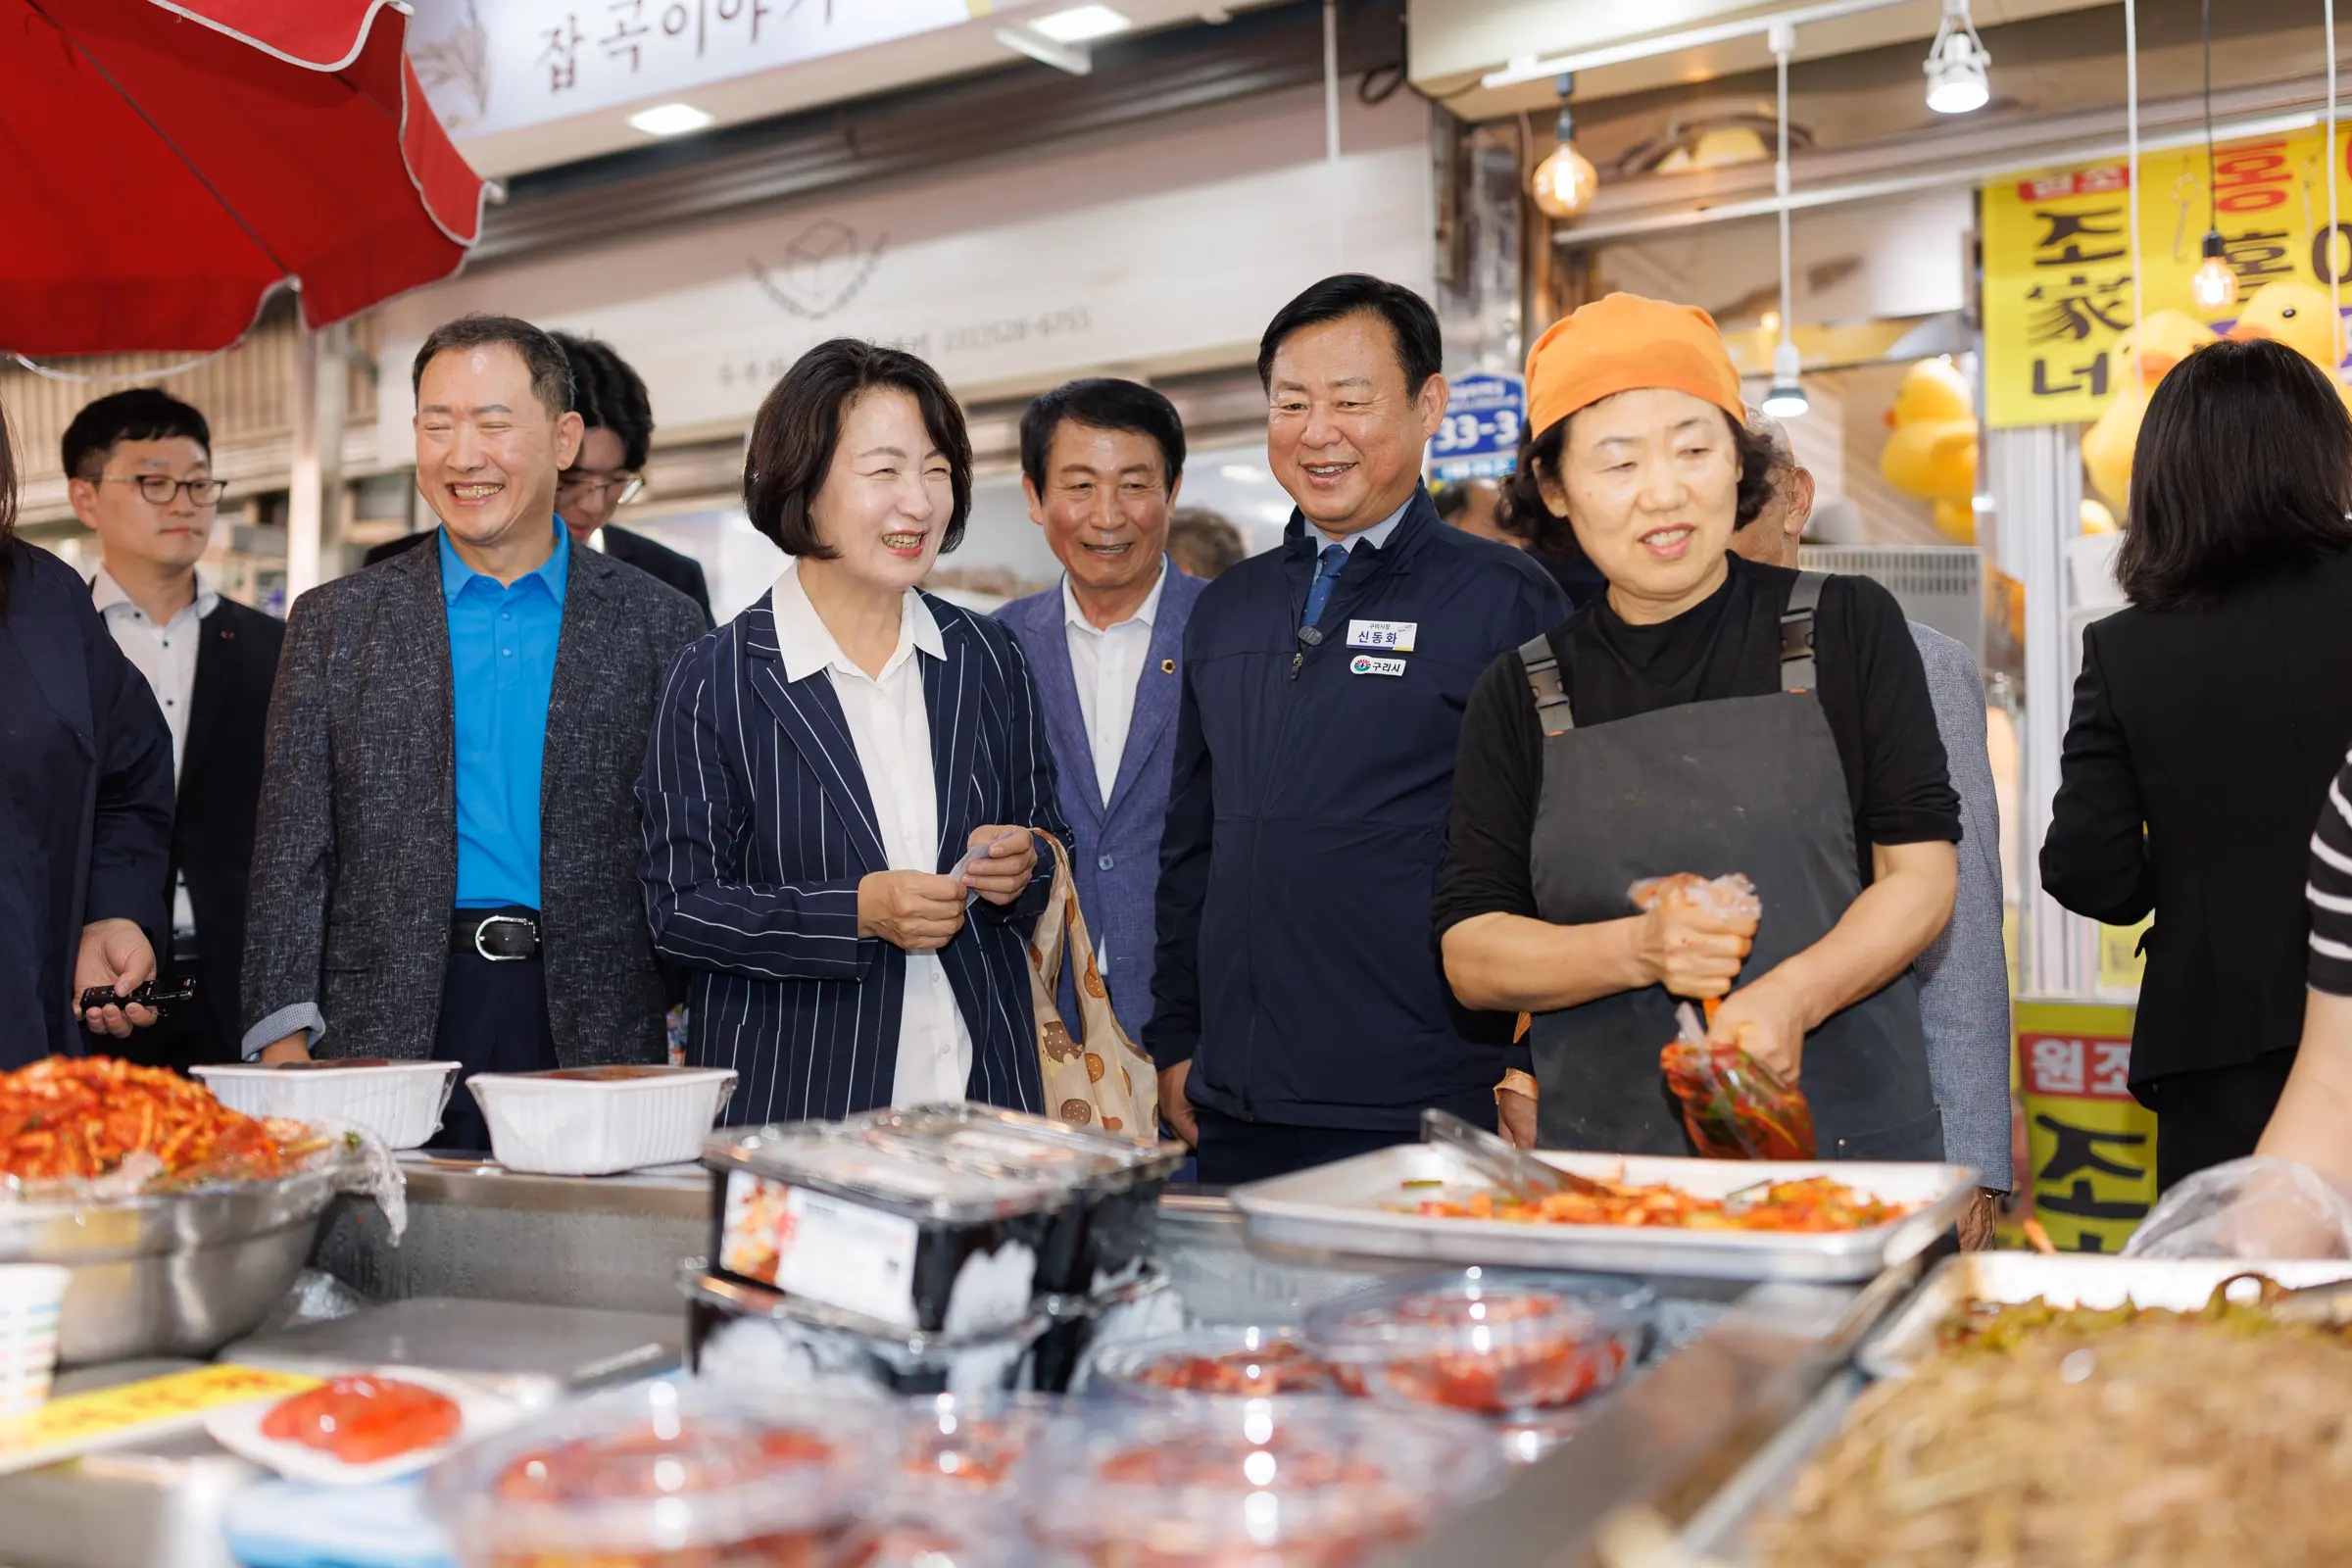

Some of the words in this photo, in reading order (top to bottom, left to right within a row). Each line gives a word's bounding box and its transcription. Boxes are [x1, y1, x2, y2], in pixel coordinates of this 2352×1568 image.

[1435, 410, 1521, 452] 33-3
[1358, 630, 1397, 645] 신동화
[1373, 662, 1401, 672] 구리시
[2031, 1038, 2131, 1095] 원조
[2034, 1113, 2151, 1252] 조
